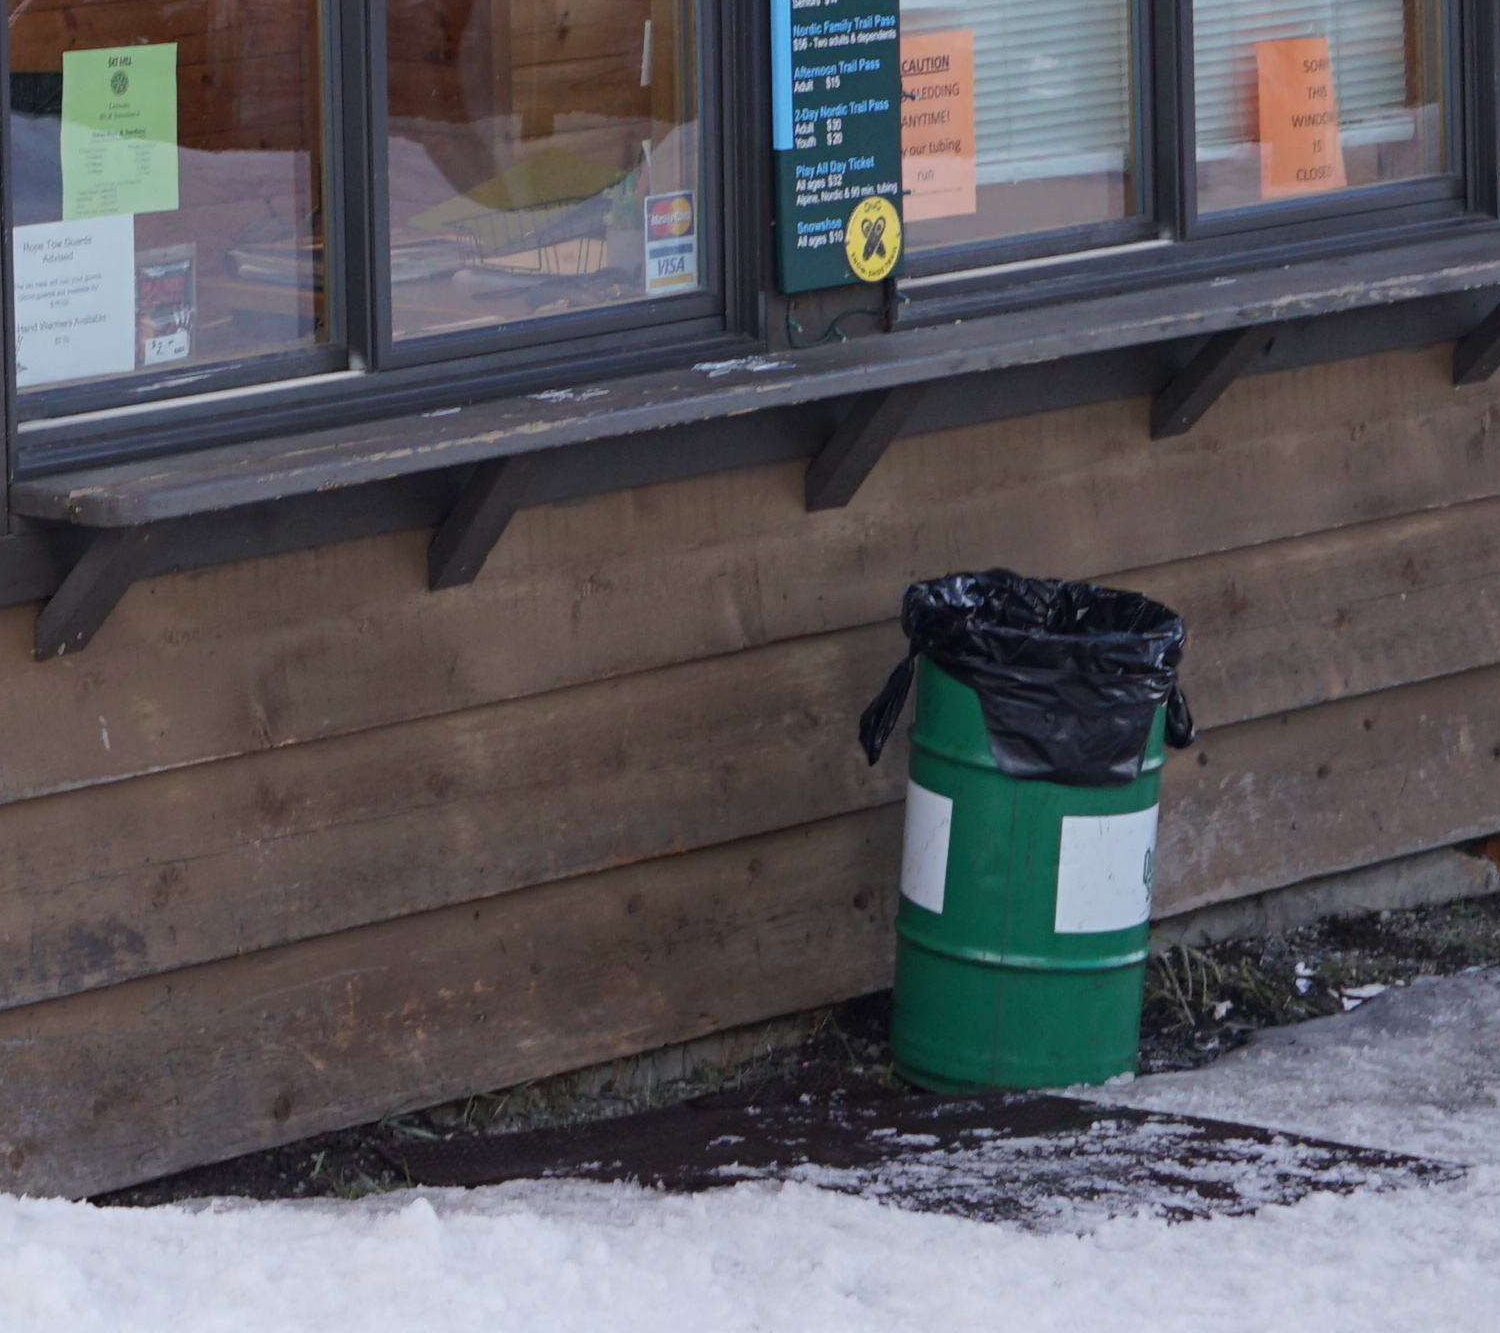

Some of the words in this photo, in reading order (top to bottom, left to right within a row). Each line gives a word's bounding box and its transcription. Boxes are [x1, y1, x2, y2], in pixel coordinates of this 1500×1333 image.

[793, 23, 822, 37] Nordic
[824, 18, 852, 34] Family
[854, 15, 873, 28] Trail
[875, 14, 895, 26] Pass
[814, 36, 827, 48] Two
[829, 34, 849, 47] adults
[857, 29, 896, 45] dependents
[120, 56, 132, 66] HILL
[794, 64, 837, 80] Afternoon
[838, 60, 857, 73] Trail
[859, 58, 881, 71] Pass
[902, 55, 949, 73] CAUTION
[794, 80, 813, 93] Adult
[1307, 86, 1328, 100] THIS
[795, 108, 818, 123] 2-Day
[820, 104, 847, 119] Nordic
[849, 101, 867, 115] Trail
[869, 99, 889, 112] Pass
[902, 110, 950, 127] ANYTIME!
[795, 122, 814, 135] Adult
[795, 136, 817, 150] Youth
[827, 132, 843, 146] $20
[910, 144, 927, 156] our
[929, 139, 961, 153] tubing
[1313, 140, 1321, 153] IS
[796, 164, 815, 178] Play
[816, 161, 828, 175] All
[830, 160, 846, 175] Day
[848, 156, 874, 170] Ticket
[917, 169, 934, 181] run
[1296, 165, 1332, 181] CLOSED
[796, 179, 806, 192] All
[807, 179, 826, 192] ages
[821, 190, 843, 204] Nordic
[851, 186, 860, 198] 90
[861, 184, 875, 197] min.
[877, 182, 897, 195] tubing
[797, 218, 842, 235] Snowshoe
[23, 241, 44, 253] Rope
[48, 239, 63, 249] Tow
[64, 235, 92, 247] Guards
[797, 236, 807, 249] All
[808, 235, 826, 249] ages
[42, 252, 73, 264] Advised
[658, 256, 685, 276] VISA
